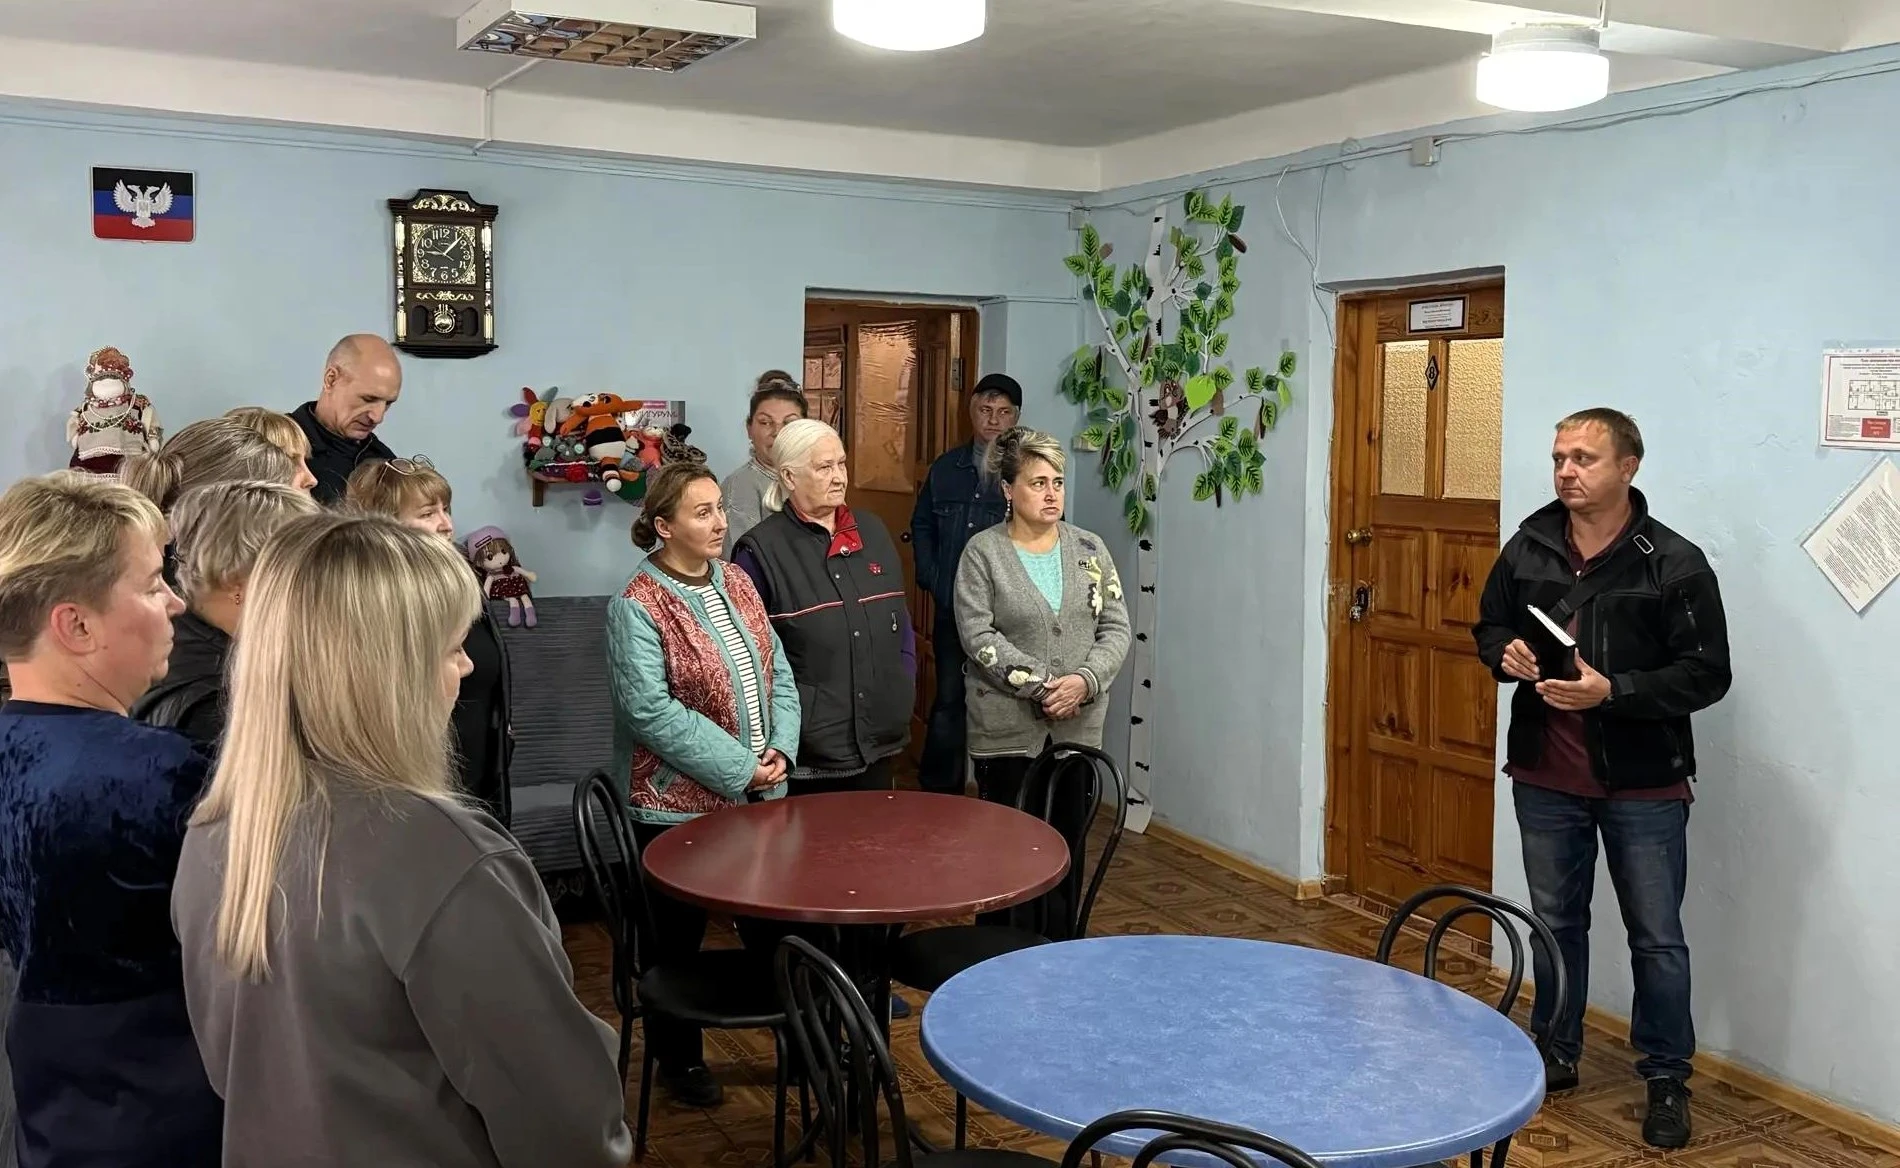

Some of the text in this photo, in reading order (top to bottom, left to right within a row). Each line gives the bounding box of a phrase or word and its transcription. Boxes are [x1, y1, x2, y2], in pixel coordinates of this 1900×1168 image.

[432, 230, 438, 240] 11
[440, 228, 450, 239] 12
[421, 238, 433, 249] 10
[460, 239, 467, 250] 2
[417, 249, 425, 258] 9
[463, 250, 470, 260] 3
[421, 259, 430, 269] 8
[430, 267, 437, 277] 7
[440, 270, 448, 280] 6
[451, 268, 459, 278] 5
